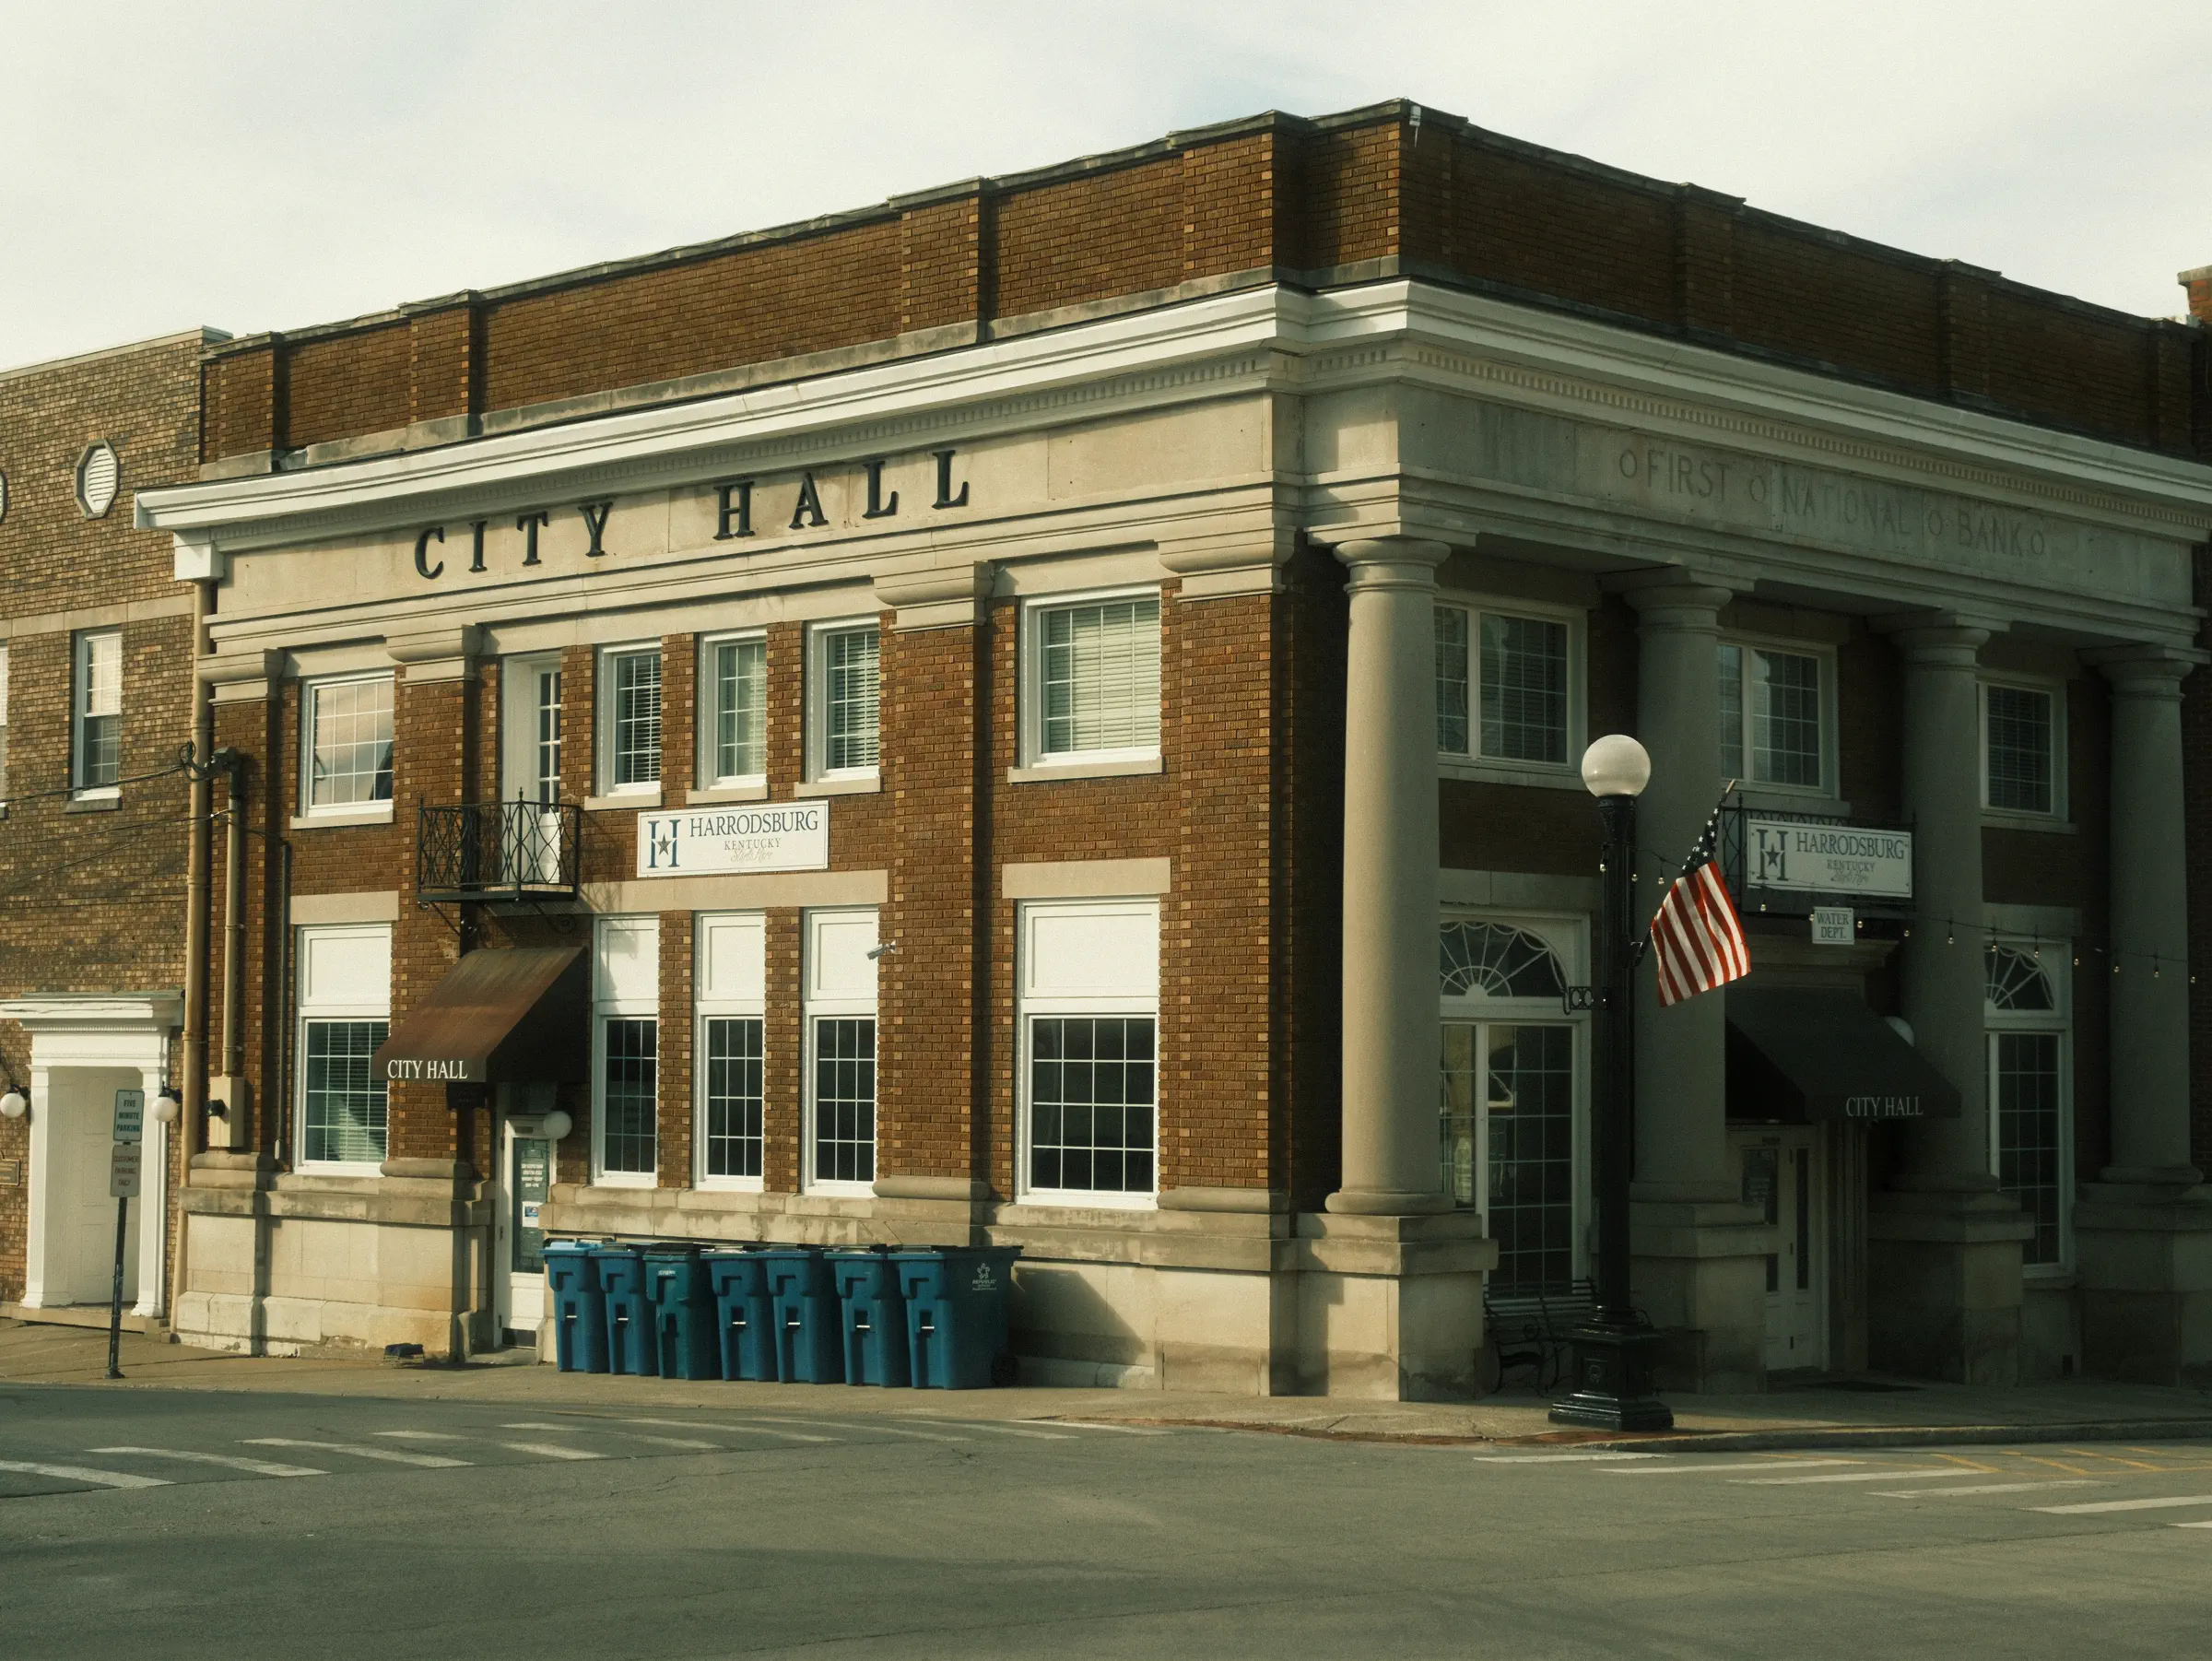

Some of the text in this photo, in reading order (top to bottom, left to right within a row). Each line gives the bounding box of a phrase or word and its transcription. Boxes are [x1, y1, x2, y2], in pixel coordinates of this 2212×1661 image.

[1645, 449, 2025, 558] FIRST NATIONAL BANK
[414, 449, 971, 580] CITY HALL
[689, 810, 818, 837] HARRODSBURG
[724, 838, 782, 850] KENTUCKY
[1795, 831, 1904, 859] HARRODSBURG
[1826, 858, 1877, 873] KENTUCKY
[1817, 913, 1850, 925] WATER
[1820, 926, 1847, 939] DEPT.
[387, 1059, 468, 1079] CITY HALL
[1845, 1096, 1924, 1117] CITY HALL
[118, 1112, 140, 1120] MINUTE
[116, 1124, 140, 1133] PARKING
